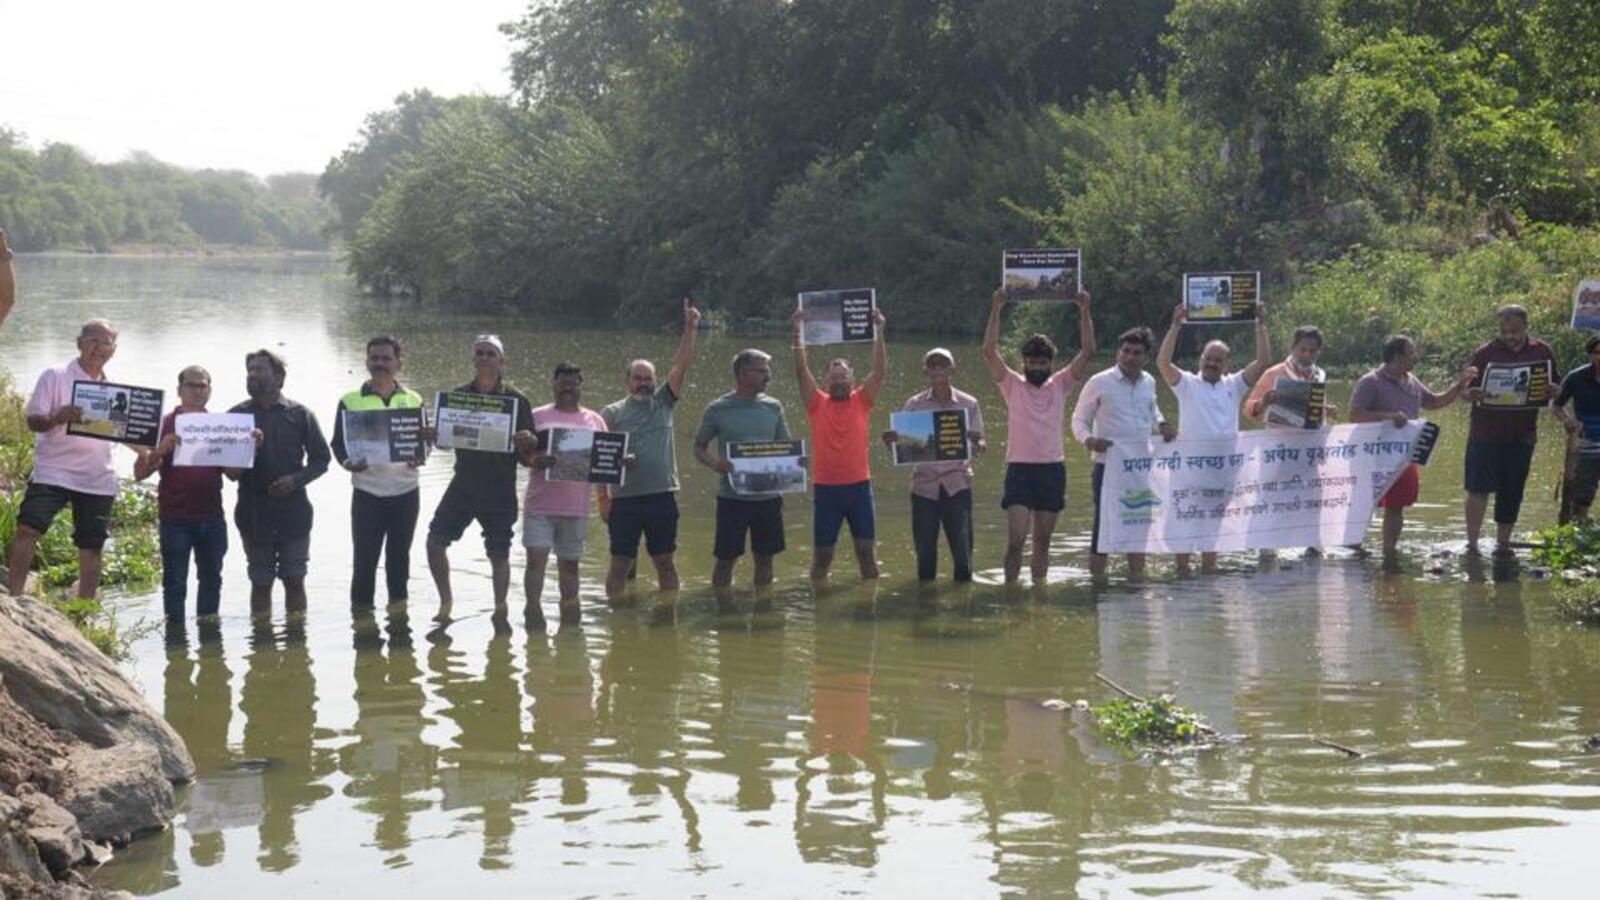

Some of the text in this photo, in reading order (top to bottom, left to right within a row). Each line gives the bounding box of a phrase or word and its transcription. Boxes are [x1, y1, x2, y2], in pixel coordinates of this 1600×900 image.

[1156, 452, 1181, 470] नदी
[1186, 455, 1227, 470] स्वच्छ
[1264, 443, 1300, 463] अवैध
